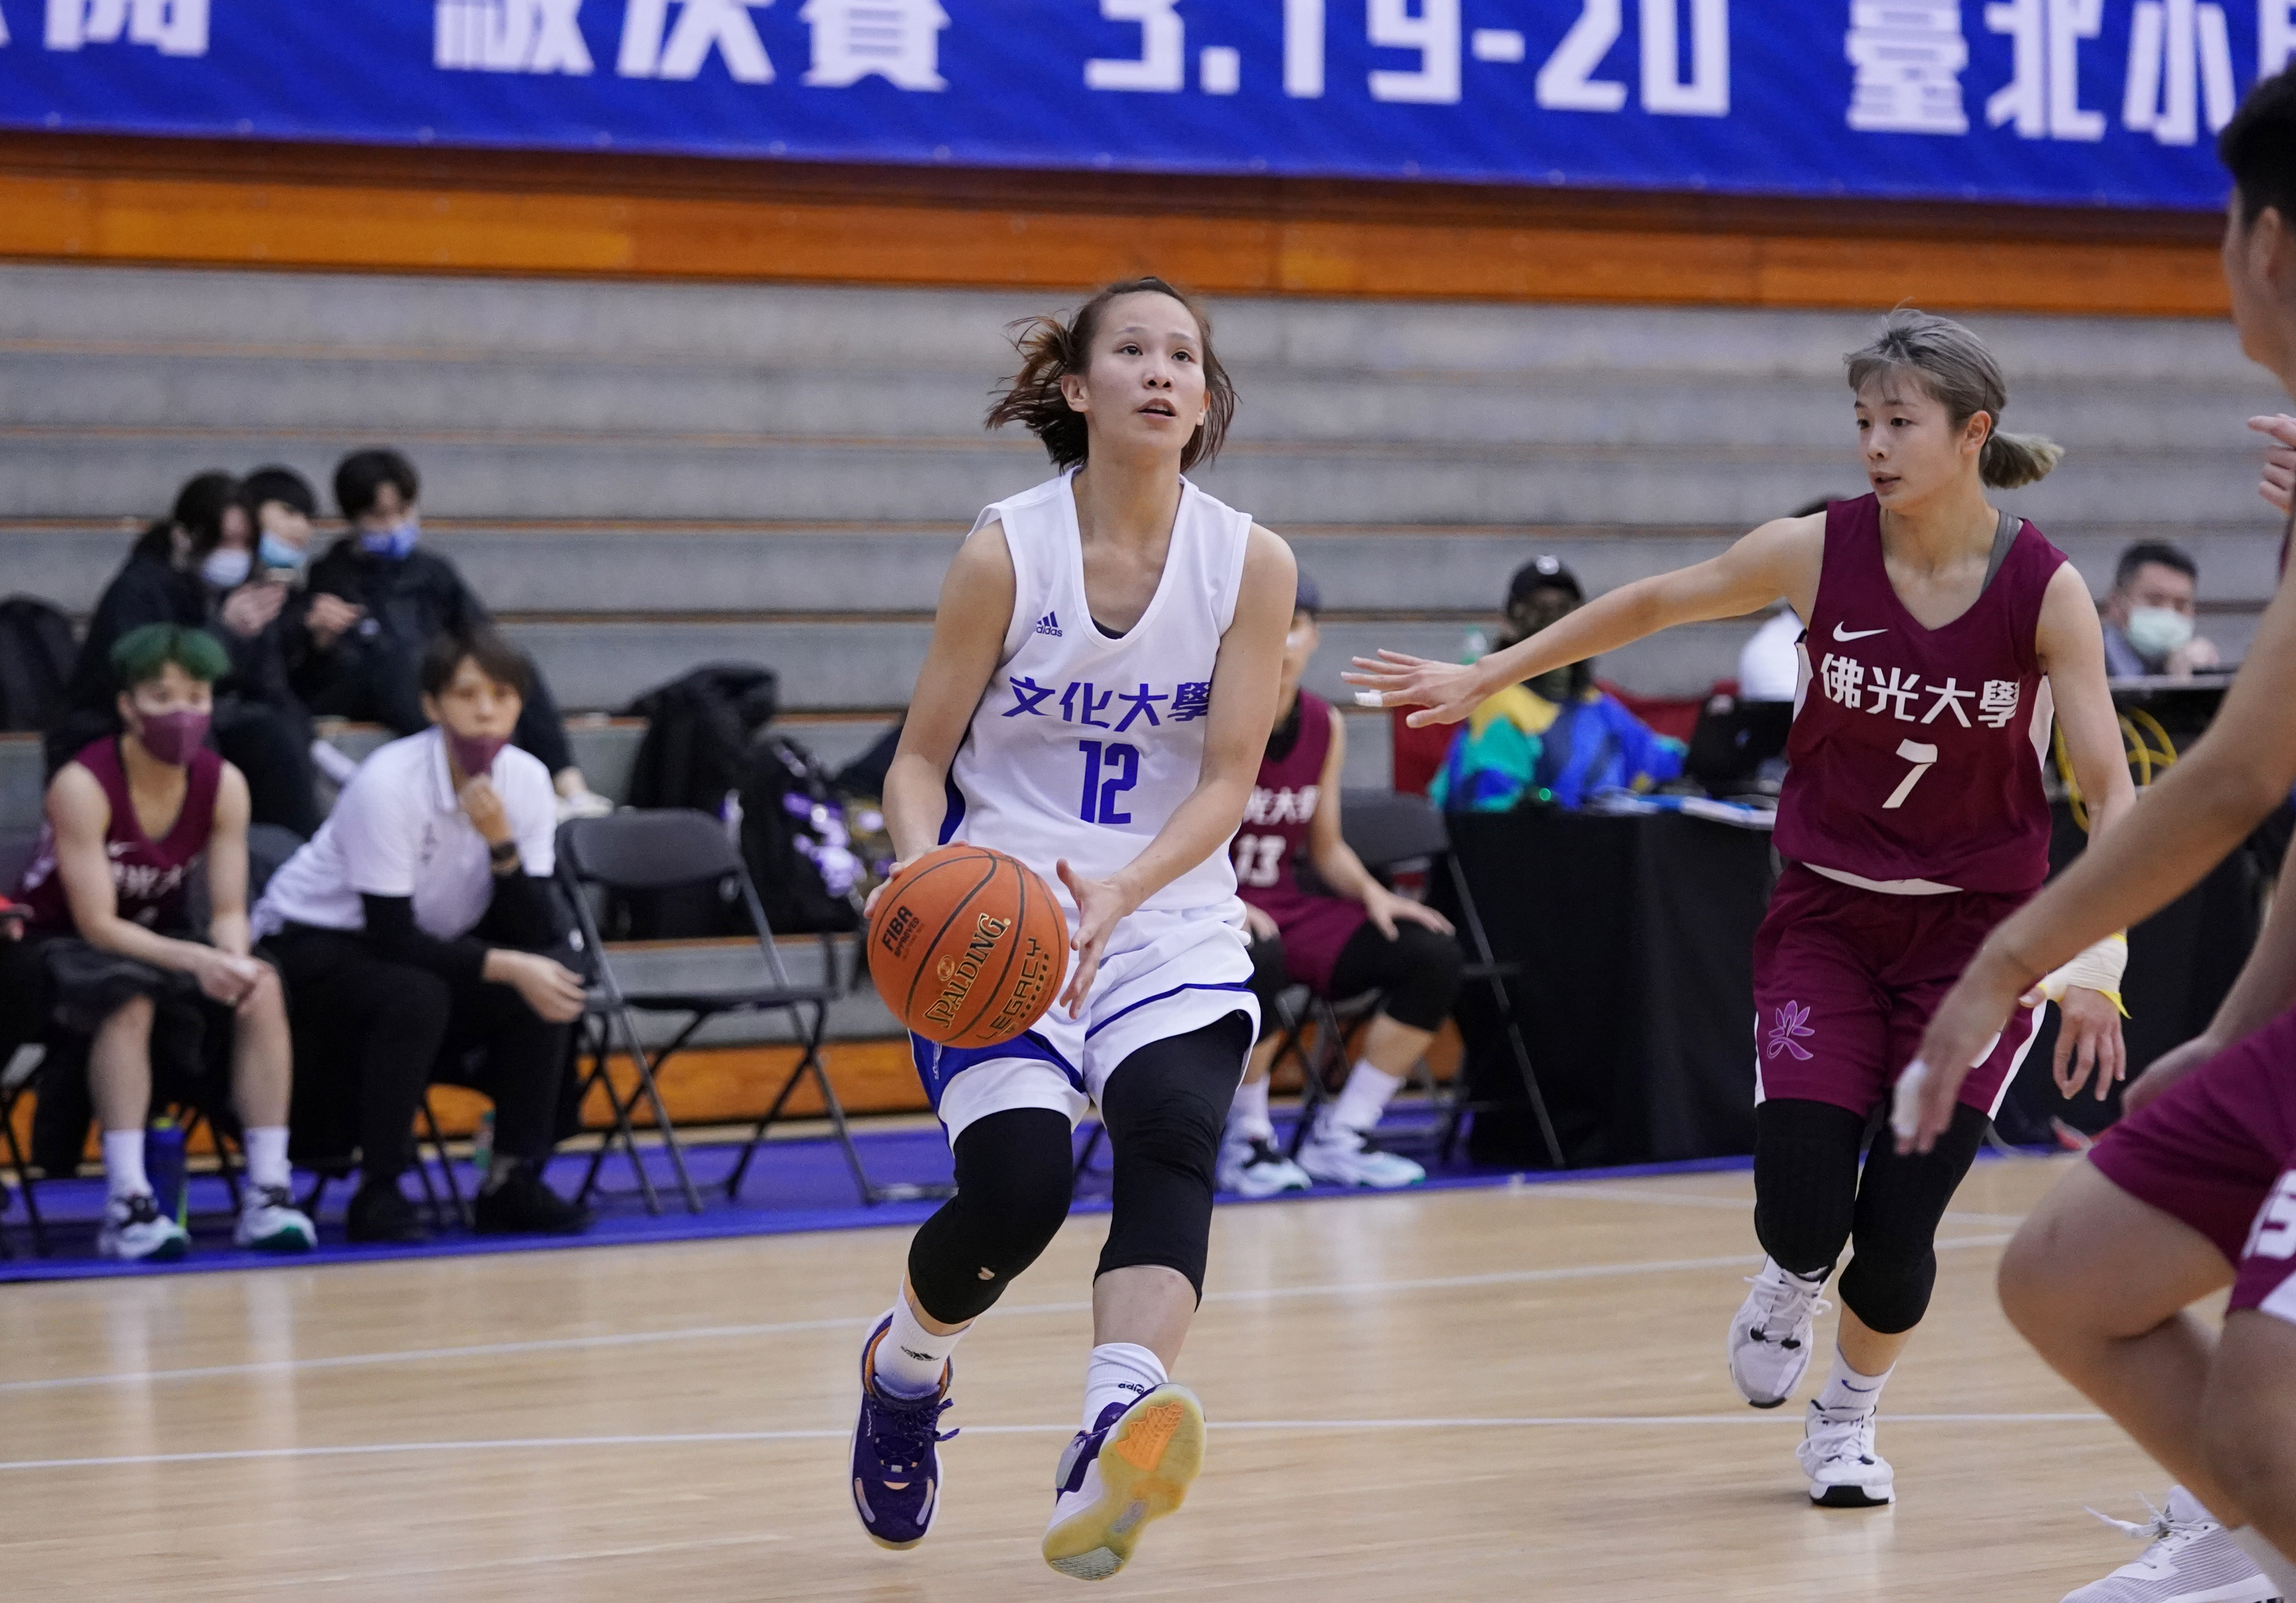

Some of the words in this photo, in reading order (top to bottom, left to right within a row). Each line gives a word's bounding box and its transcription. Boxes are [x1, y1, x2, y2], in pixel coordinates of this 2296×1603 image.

[1845, 0, 2296, 146] 臺北小
[1036, 625, 1063, 637] didas
[1002, 676, 1211, 732] 文化大學
[1821, 653, 2020, 728] 佛光大學
[1079, 740, 1140, 824] 12
[1882, 738, 1938, 809] 7
[1235, 834, 1287, 888] 13
[882, 905, 914, 951] FIBA
[923, 912, 1011, 1029] SPALDING
[976, 937, 1041, 1039] LEGACY
